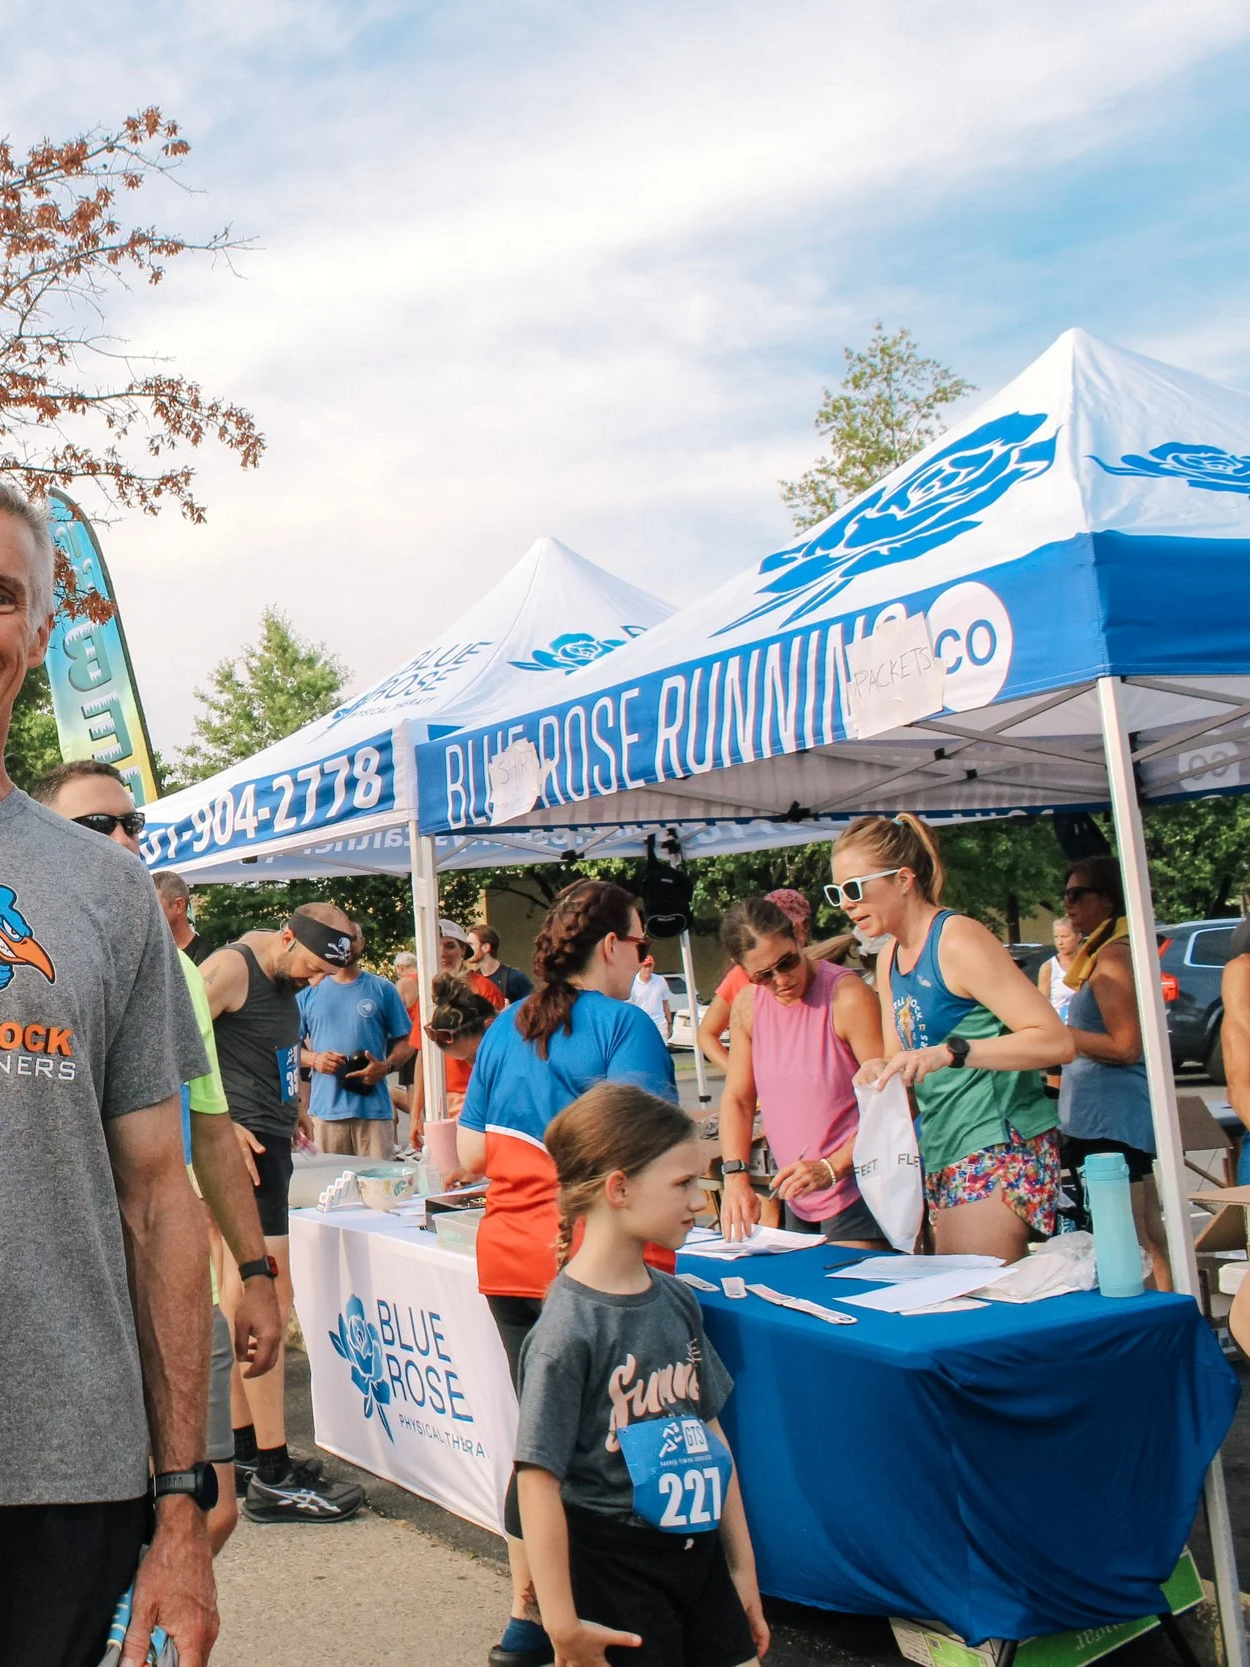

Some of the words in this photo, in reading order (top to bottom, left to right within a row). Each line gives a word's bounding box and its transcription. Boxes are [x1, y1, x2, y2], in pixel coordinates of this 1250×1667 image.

[372, 667, 462, 702] ROSE
[399, 641, 494, 675] BLUE
[853, 646, 932, 699] PACKETS
[538, 687, 646, 809] ROSE
[655, 602, 908, 784] RUNNIN
[934, 619, 998, 675] CO
[376, 1299, 452, 1363] BLUE
[386, 1354, 473, 1423] ROSE
[398, 1414, 444, 1443] PHYSICAL
[684, 1424, 706, 1448] GTS
[658, 1466, 722, 1527] 227
